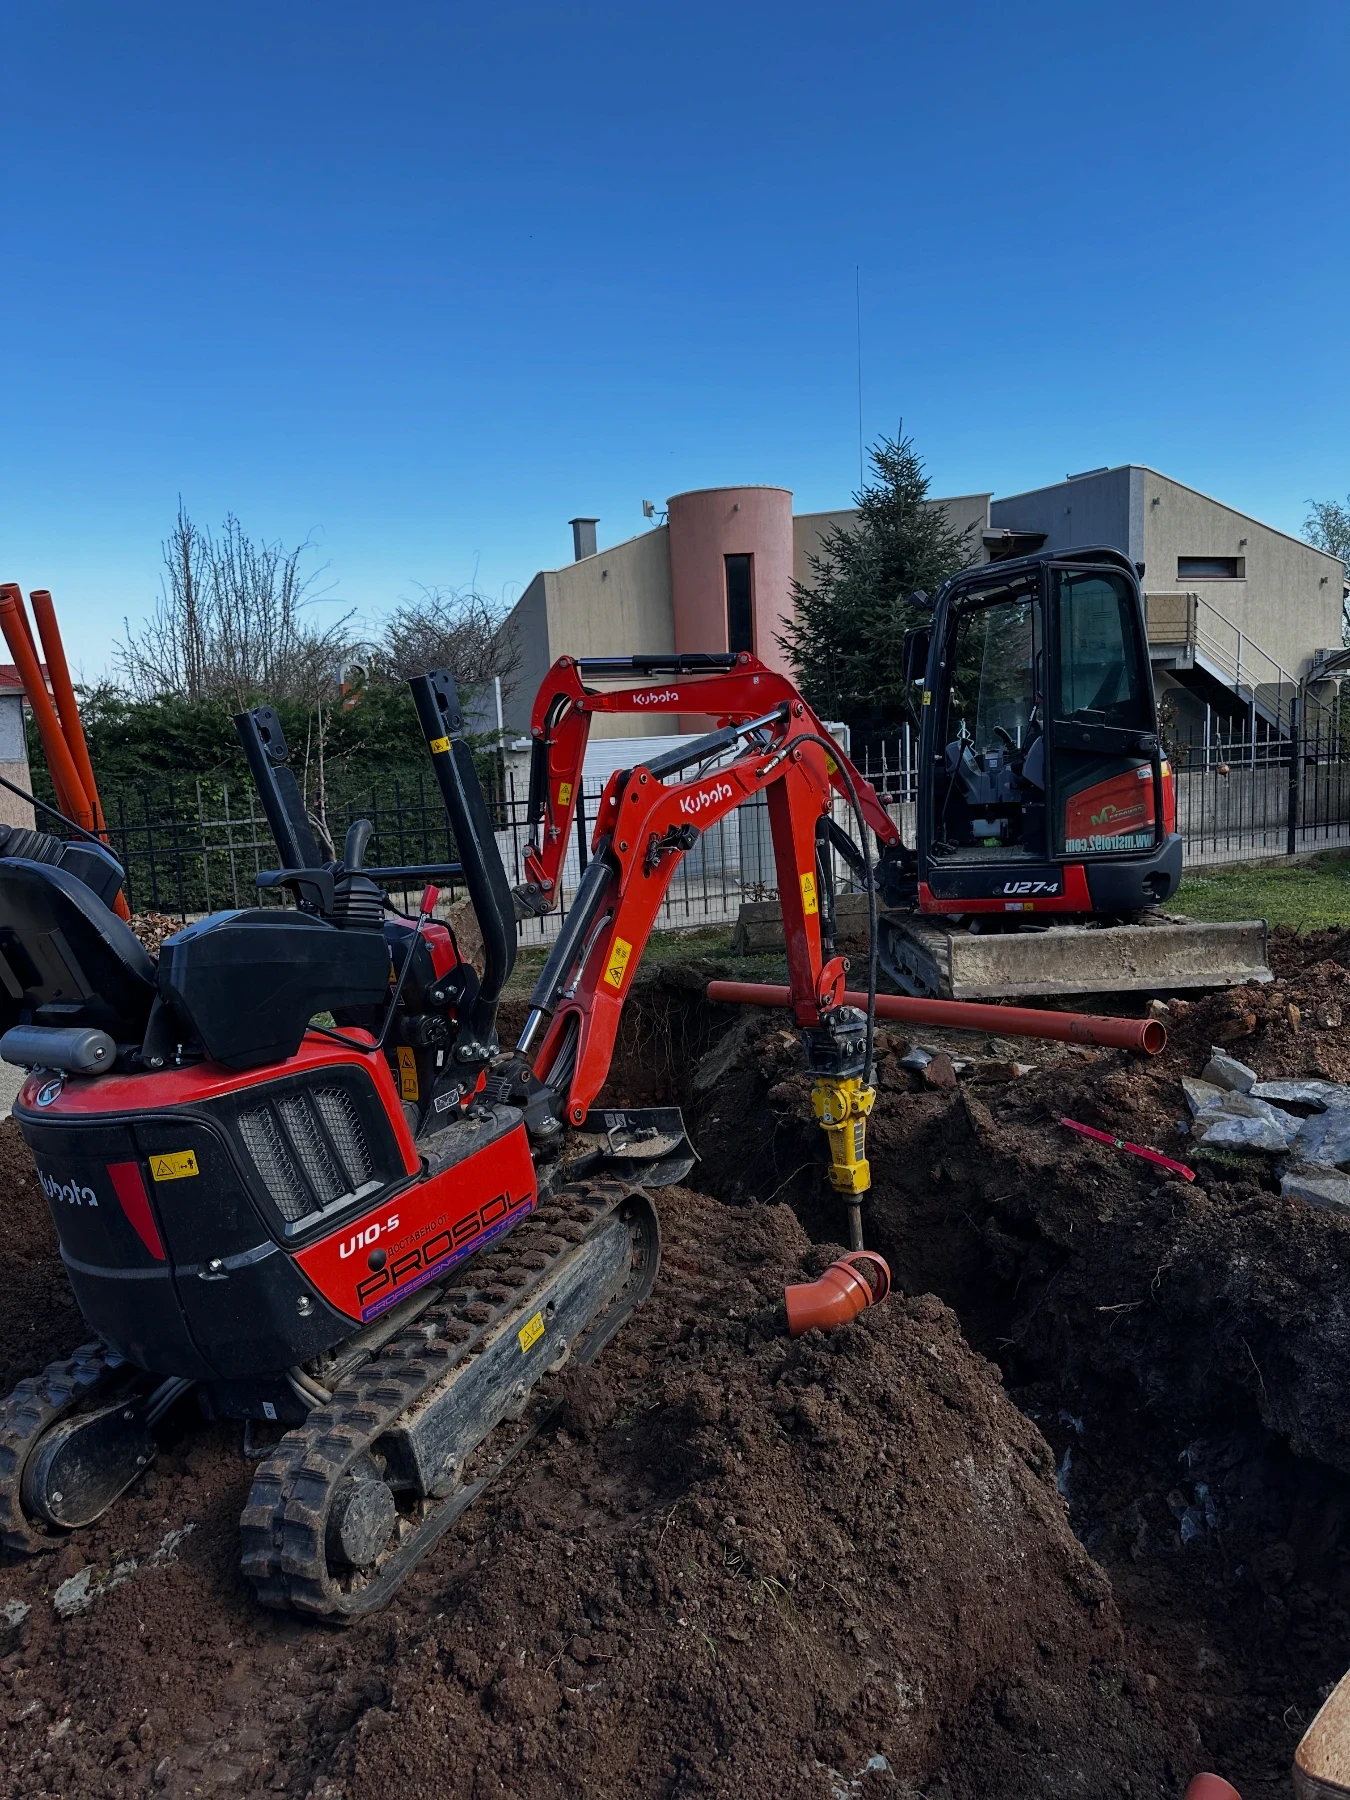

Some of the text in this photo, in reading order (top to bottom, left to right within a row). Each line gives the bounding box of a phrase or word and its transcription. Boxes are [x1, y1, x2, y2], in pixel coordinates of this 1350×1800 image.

[632, 690, 679, 705] Kubota
[680, 783, 733, 814] Kubota
[1003, 881, 1059, 894] U27-4
[37, 1167, 98, 1207] Kubota
[339, 1214, 400, 1260] U10-5
[355, 1190, 533, 1307] PROSOL
[387, 1214, 451, 1258] ДОСТАВЕНО ОТ:
[366, 1204, 531, 1318] PROFESSIONAL SOLUTIONS
